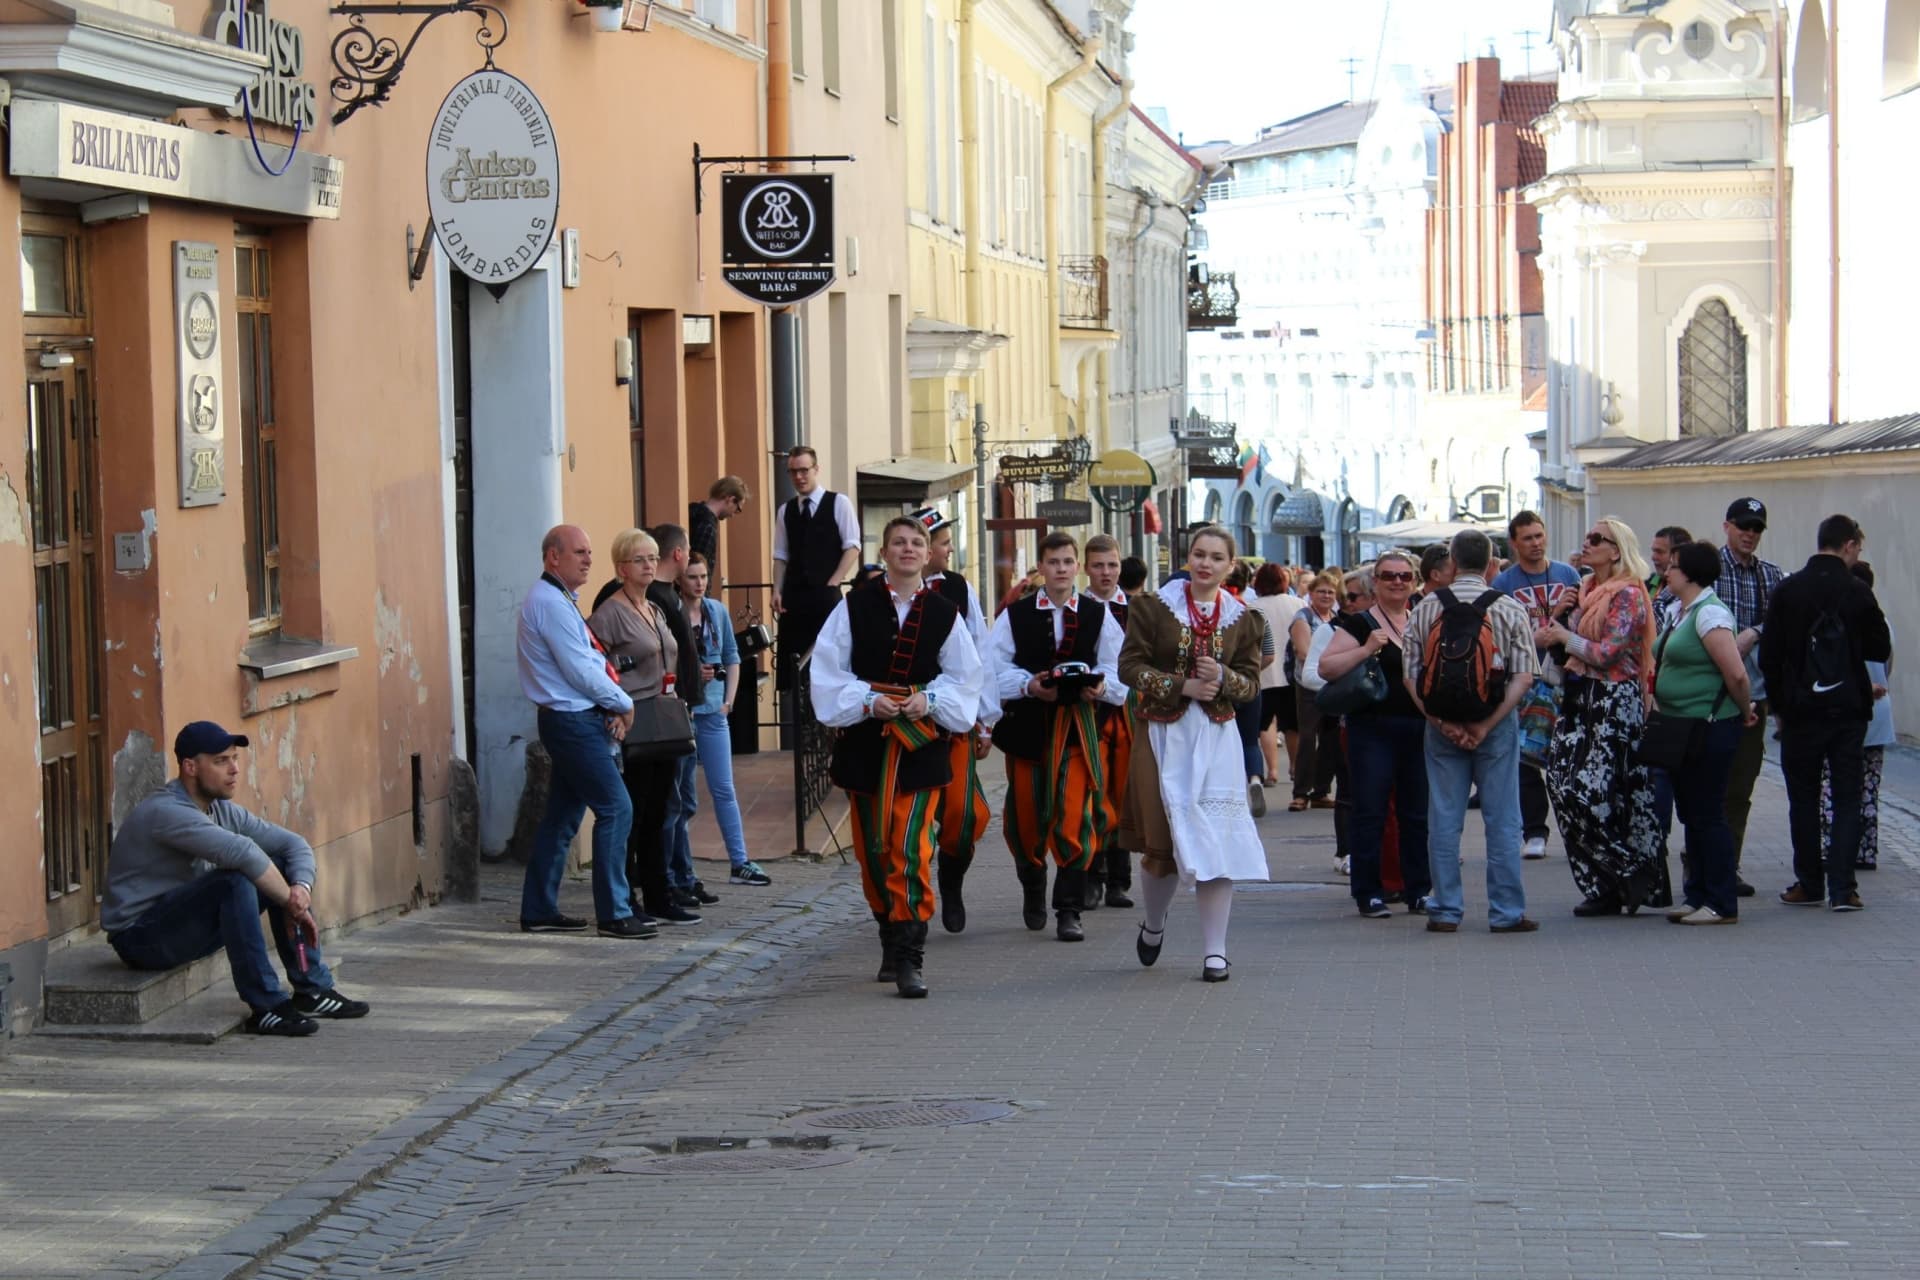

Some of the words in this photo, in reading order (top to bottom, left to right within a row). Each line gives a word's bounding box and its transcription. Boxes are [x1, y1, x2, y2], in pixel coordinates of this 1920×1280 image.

[435, 79, 501, 151] JUVELYRINIAI
[503, 84, 548, 149] DIRBINIAI
[71, 120, 180, 181] BRILIANTAS
[453, 145, 537, 178] Aukso
[440, 167, 550, 203] Centras
[441, 217, 546, 277] LOMBARDAS
[728, 271, 786, 282] SENOVINIŲ
[787, 269, 830, 282] GĖRIMŲ
[760, 283, 797, 292] BARAS
[1002, 464, 1070, 477] SUVENYRAI
